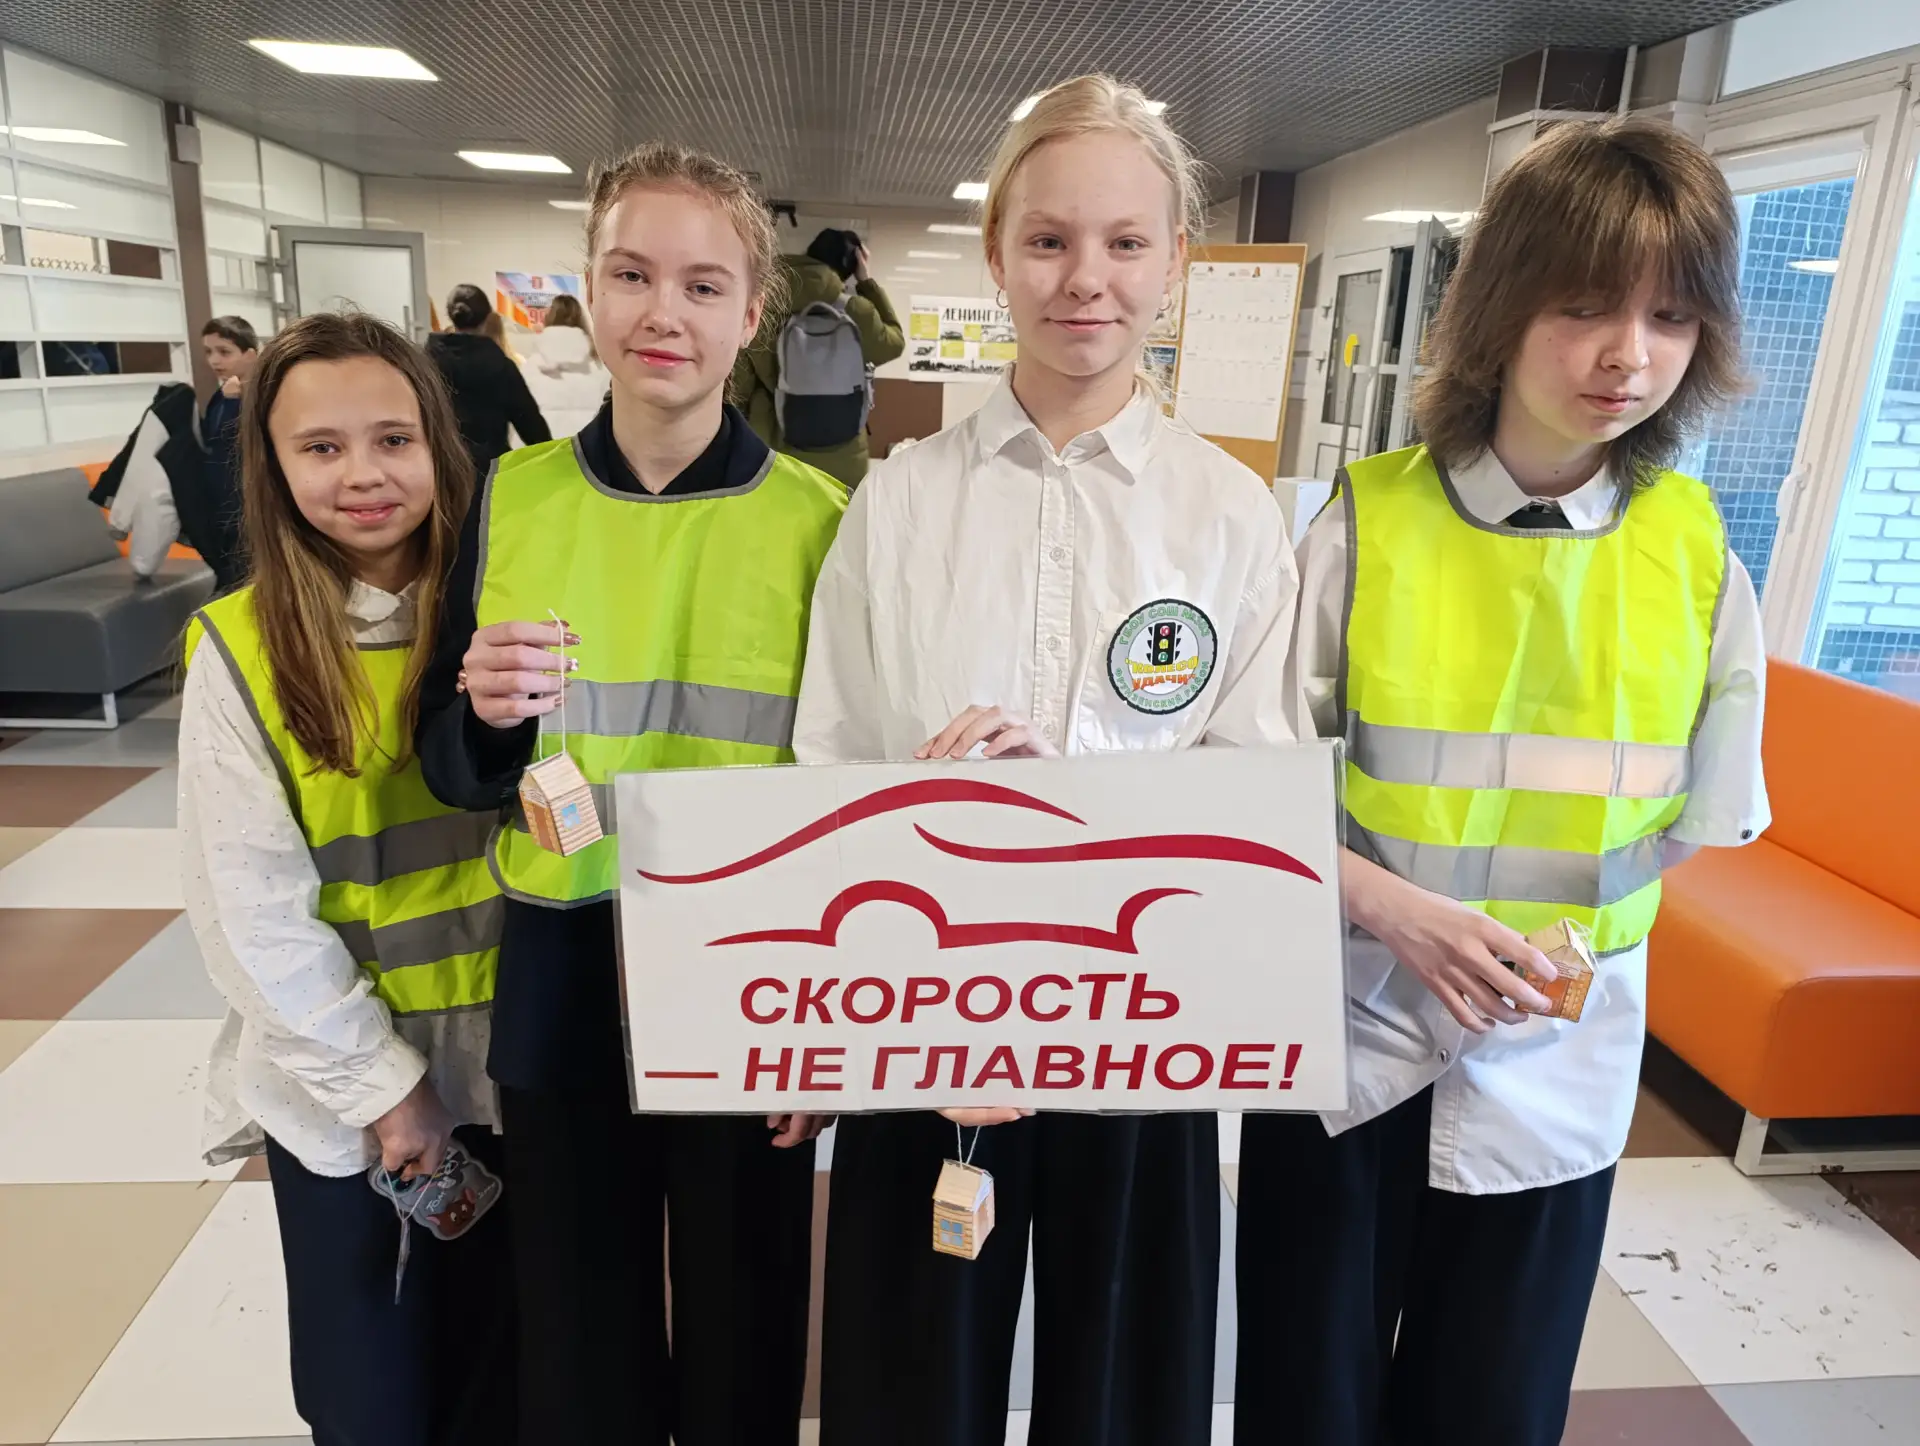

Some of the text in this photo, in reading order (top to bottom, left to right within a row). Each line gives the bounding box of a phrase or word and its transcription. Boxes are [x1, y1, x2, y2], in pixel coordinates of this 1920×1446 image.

[740, 973, 1180, 1025] СКОРОСТЬ
[743, 1046, 845, 1092] НЕ
[872, 1043, 1303, 1091] ГЛАВНОЕ!
